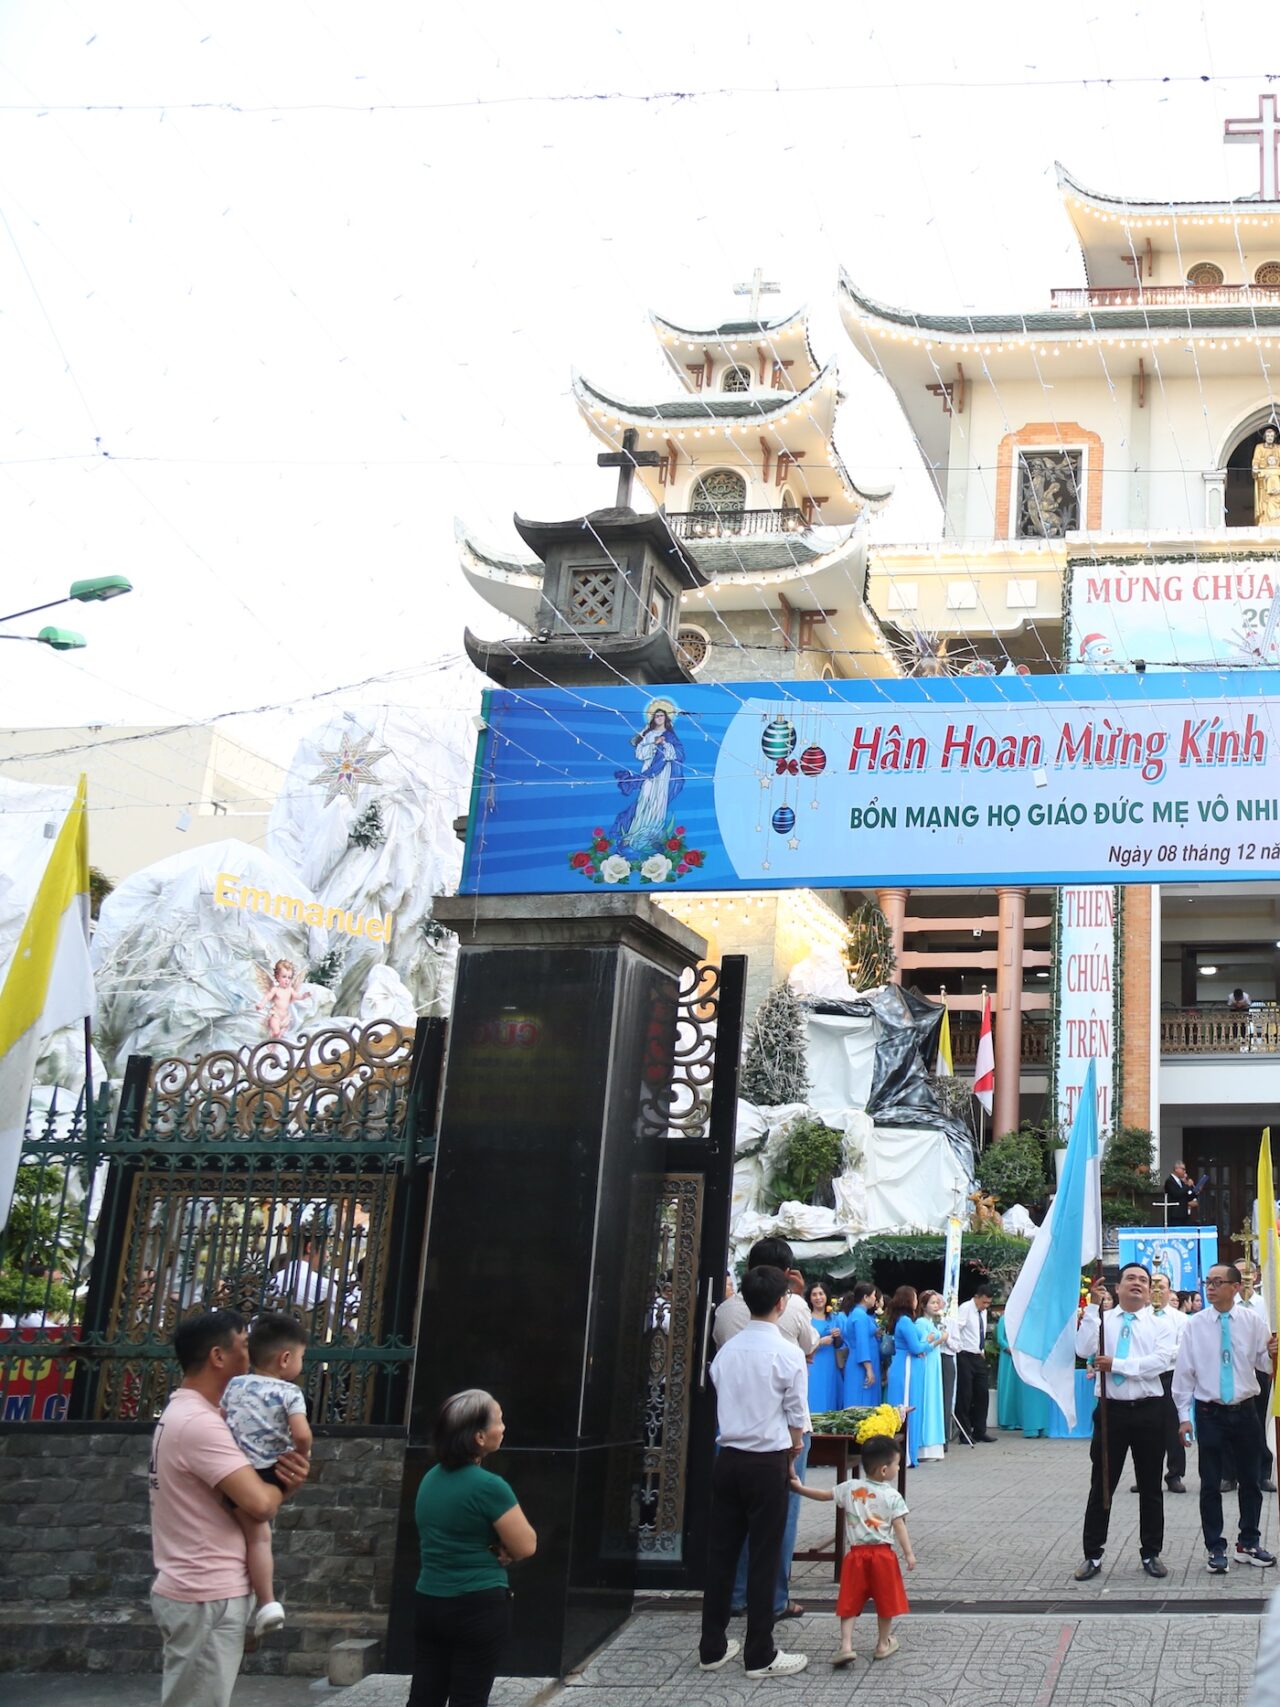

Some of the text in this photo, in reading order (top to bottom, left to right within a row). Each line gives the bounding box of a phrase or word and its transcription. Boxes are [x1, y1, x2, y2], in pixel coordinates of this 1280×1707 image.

[1086, 570, 1183, 603] MỪNG
[1192, 567, 1274, 600] CHÚA
[848, 724, 938, 771] Hân
[942, 723, 1044, 769] Hoan
[1055, 718, 1168, 781] Mừng
[1178, 713, 1264, 765] Kính
[850, 797, 897, 829] BỔN
[905, 806, 980, 833] MẠNG
[987, 807, 1021, 832] HỌ
[1028, 797, 1088, 827] GIÁO
[1093, 795, 1144, 825] ĐỨC
[1152, 801, 1189, 829] MẸ
[1198, 794, 1229, 823] VÔ
[1108, 845, 1152, 865] Ngày
[1157, 845, 1177, 862] 08
[1182, 843, 1233, 866] tháng
[1237, 843, 1256, 860] 12
[213, 872, 394, 944] Emmanuel
[1066, 943, 1111, 993] CHÚA
[1066, 1008, 1110, 1058] TRÊN
